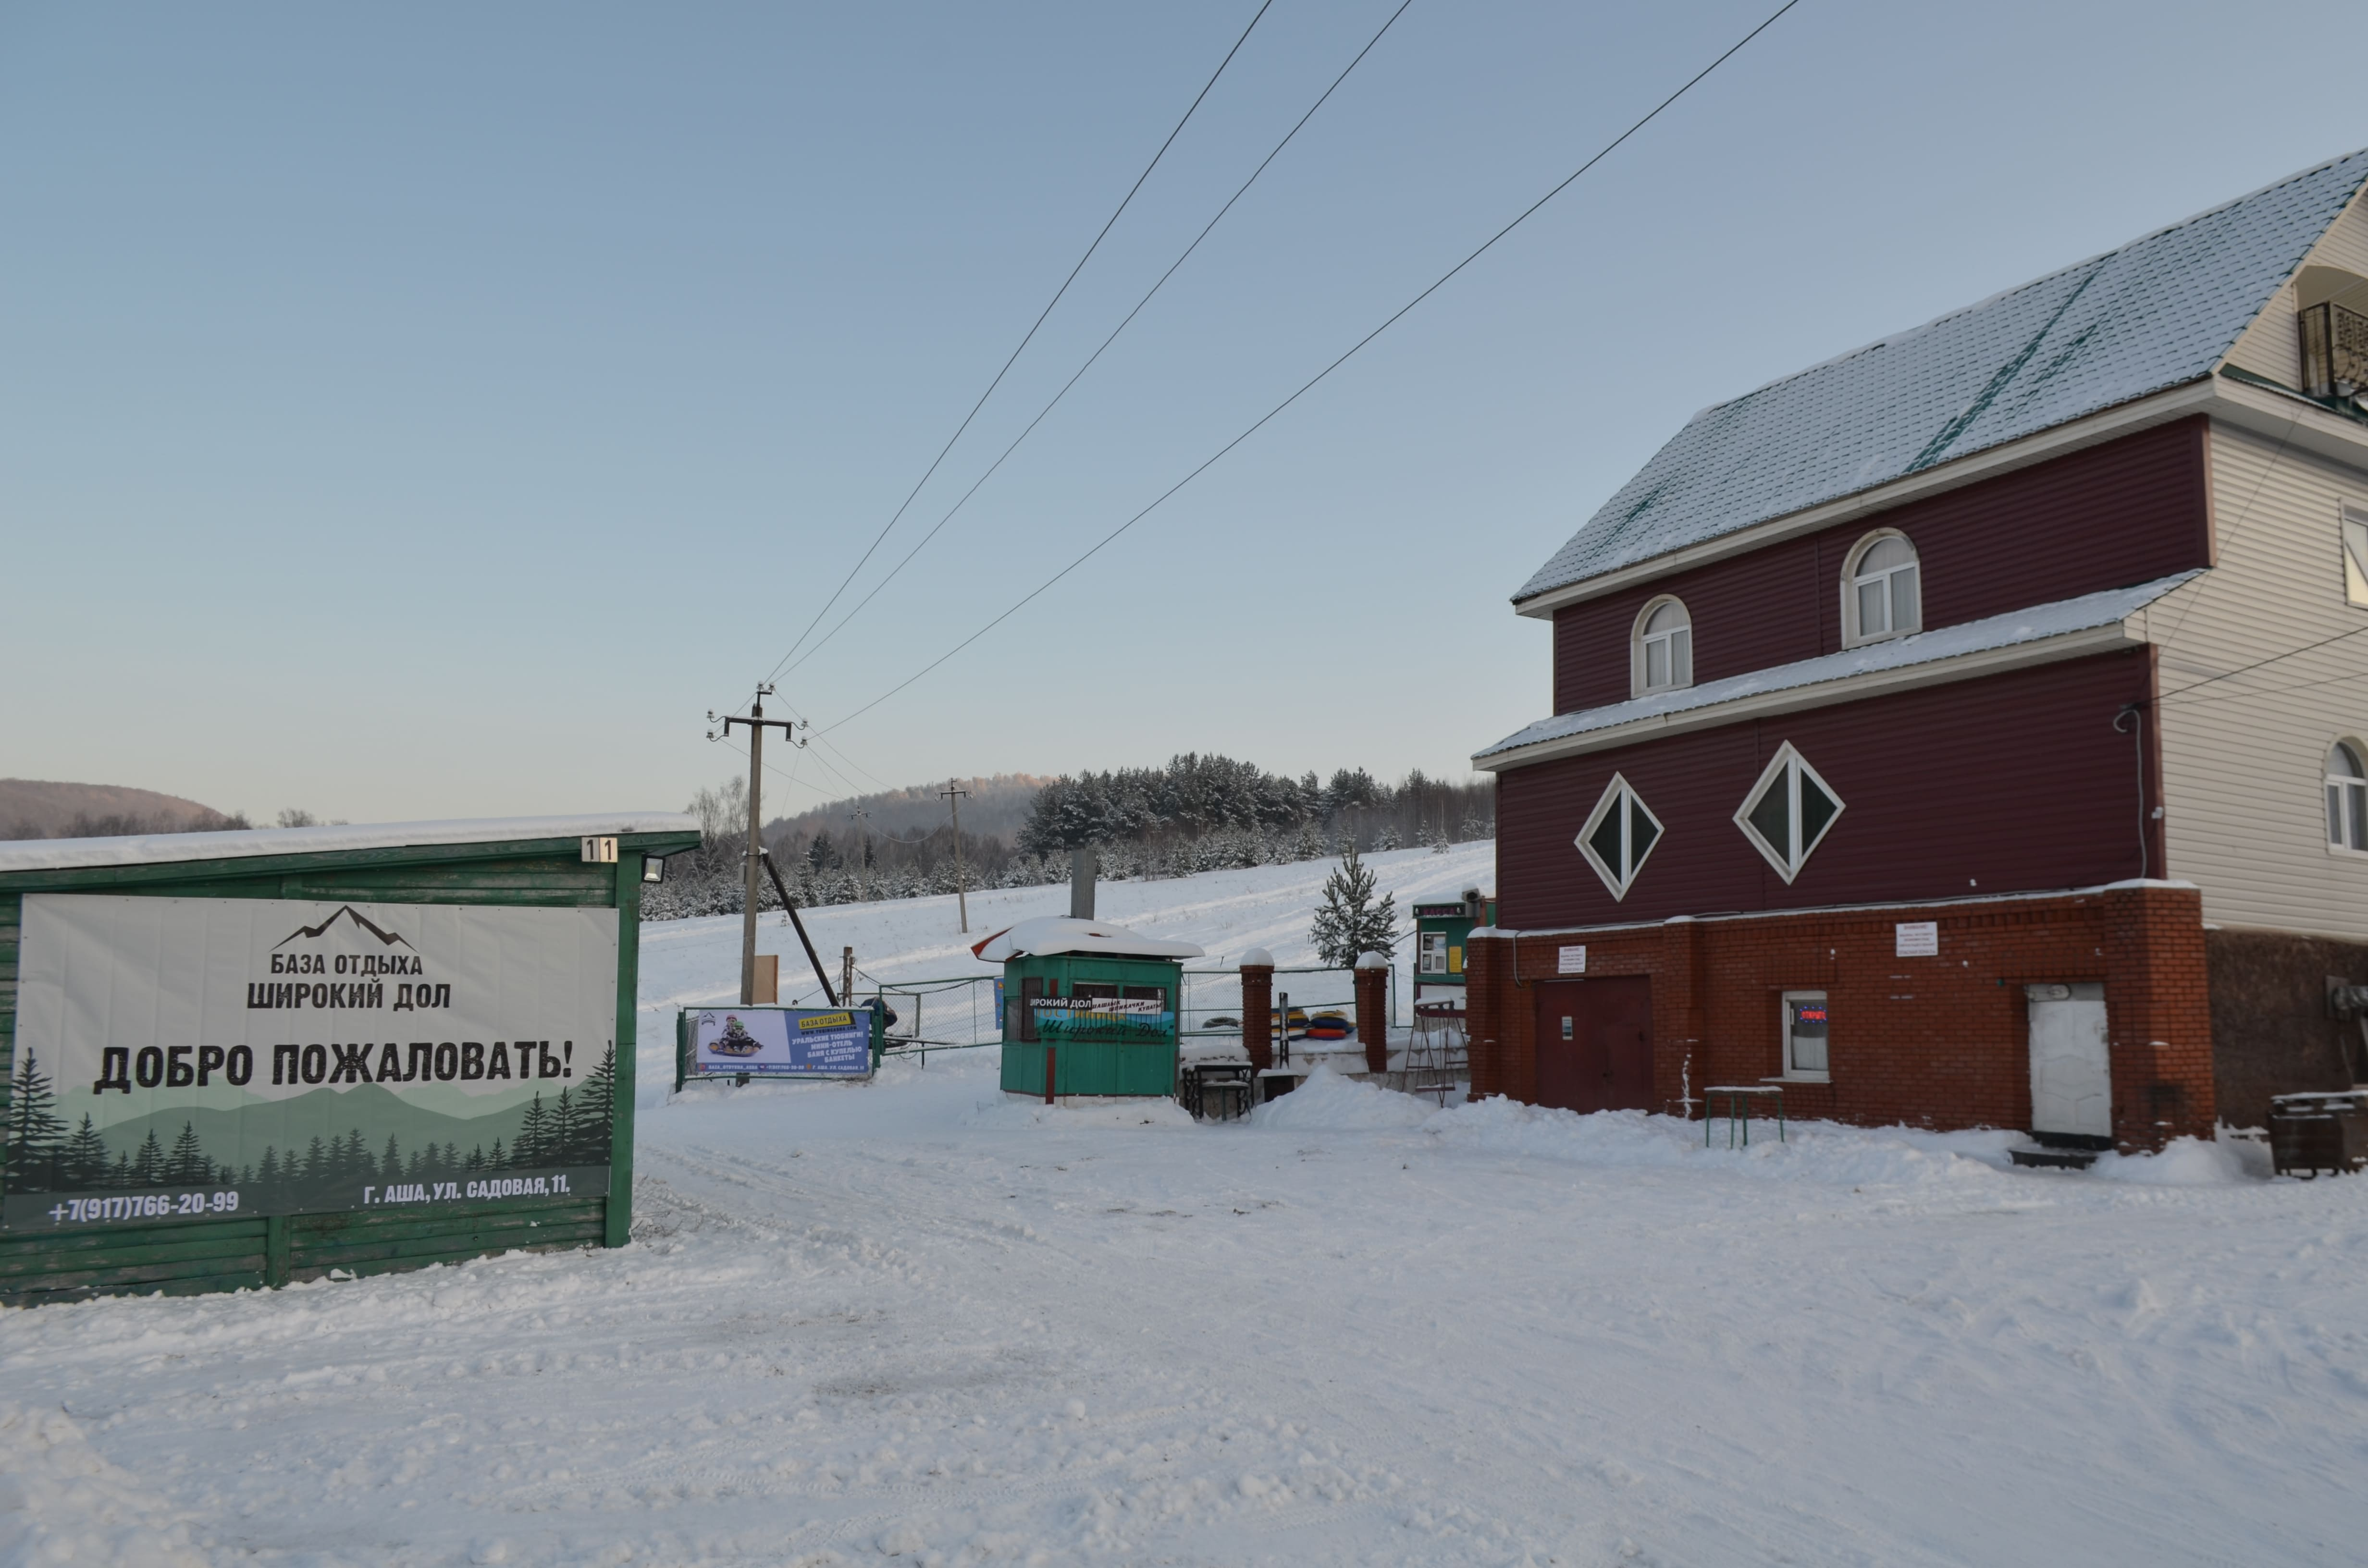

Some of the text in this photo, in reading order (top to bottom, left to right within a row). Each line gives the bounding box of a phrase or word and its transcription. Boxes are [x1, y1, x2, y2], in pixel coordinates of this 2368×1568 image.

[271, 954, 423, 977] БАЗА ОТДЫХА
[247, 978, 451, 1012] ШИРОКИЙ ДОЛ
[1070, 1000, 1091, 1009] ДОЛ
[1138, 1003, 1162, 1013] КУПАТЫ
[819, 1015, 847, 1025] ОТДЫХА
[792, 1031, 863, 1045] УРАЛЬСКИЕ ТЮБИНГИ!
[811, 1040, 853, 1050] МИНИ-ОТЕЛЬ
[830, 1046, 862, 1055] КУПЕЛЬЮ
[824, 1054, 855, 1063] БАНКЕТЫ
[93, 1041, 573, 1094] ДОБРО ПОЖАЛОВАТЬ!
[364, 1175, 570, 1204] Г. АША, УЛ. САДОВАЯ, 11.
[49, 1191, 239, 1223] +7(917)766-20-99
